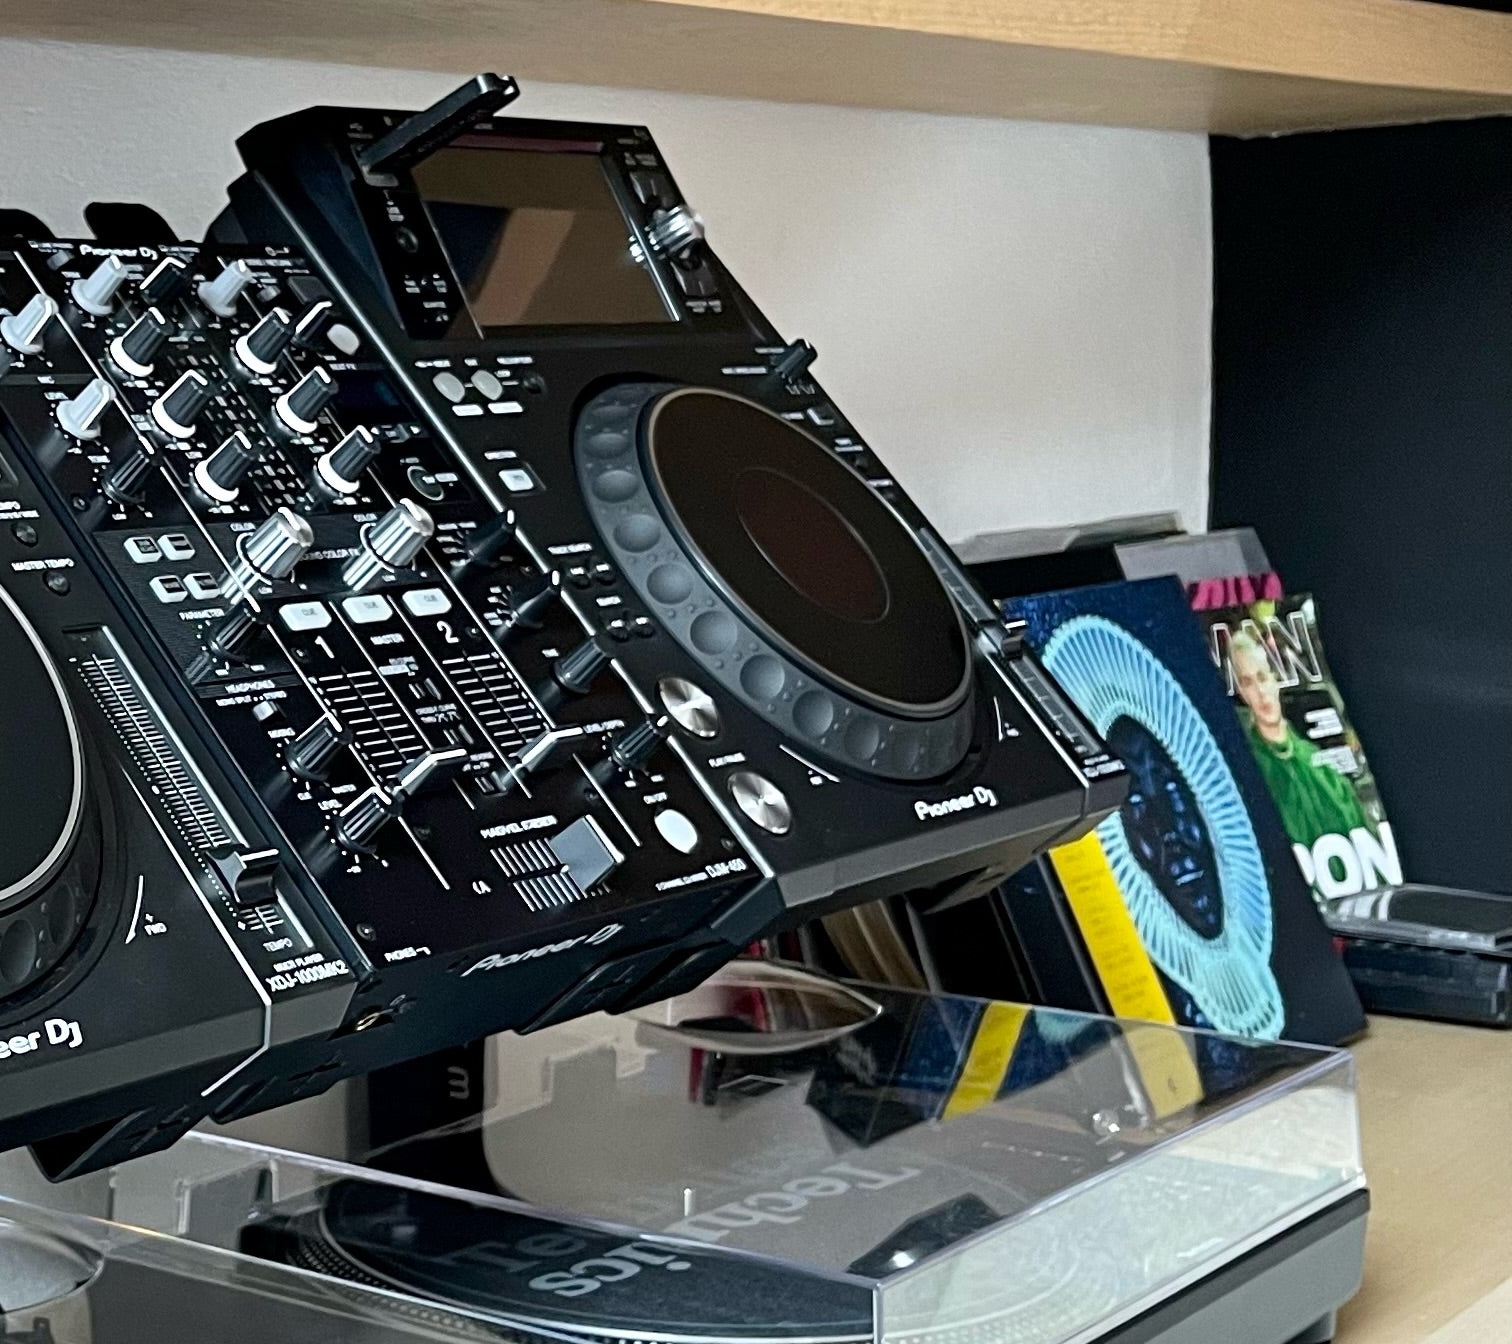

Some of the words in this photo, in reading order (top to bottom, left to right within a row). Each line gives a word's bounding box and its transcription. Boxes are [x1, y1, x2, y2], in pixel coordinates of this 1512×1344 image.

[315, 635, 335, 659] 1
[436, 620, 460, 644] 2
[914, 793, 976, 821] Pioneer
[265, 959, 350, 992] XDJ-1000MK2
